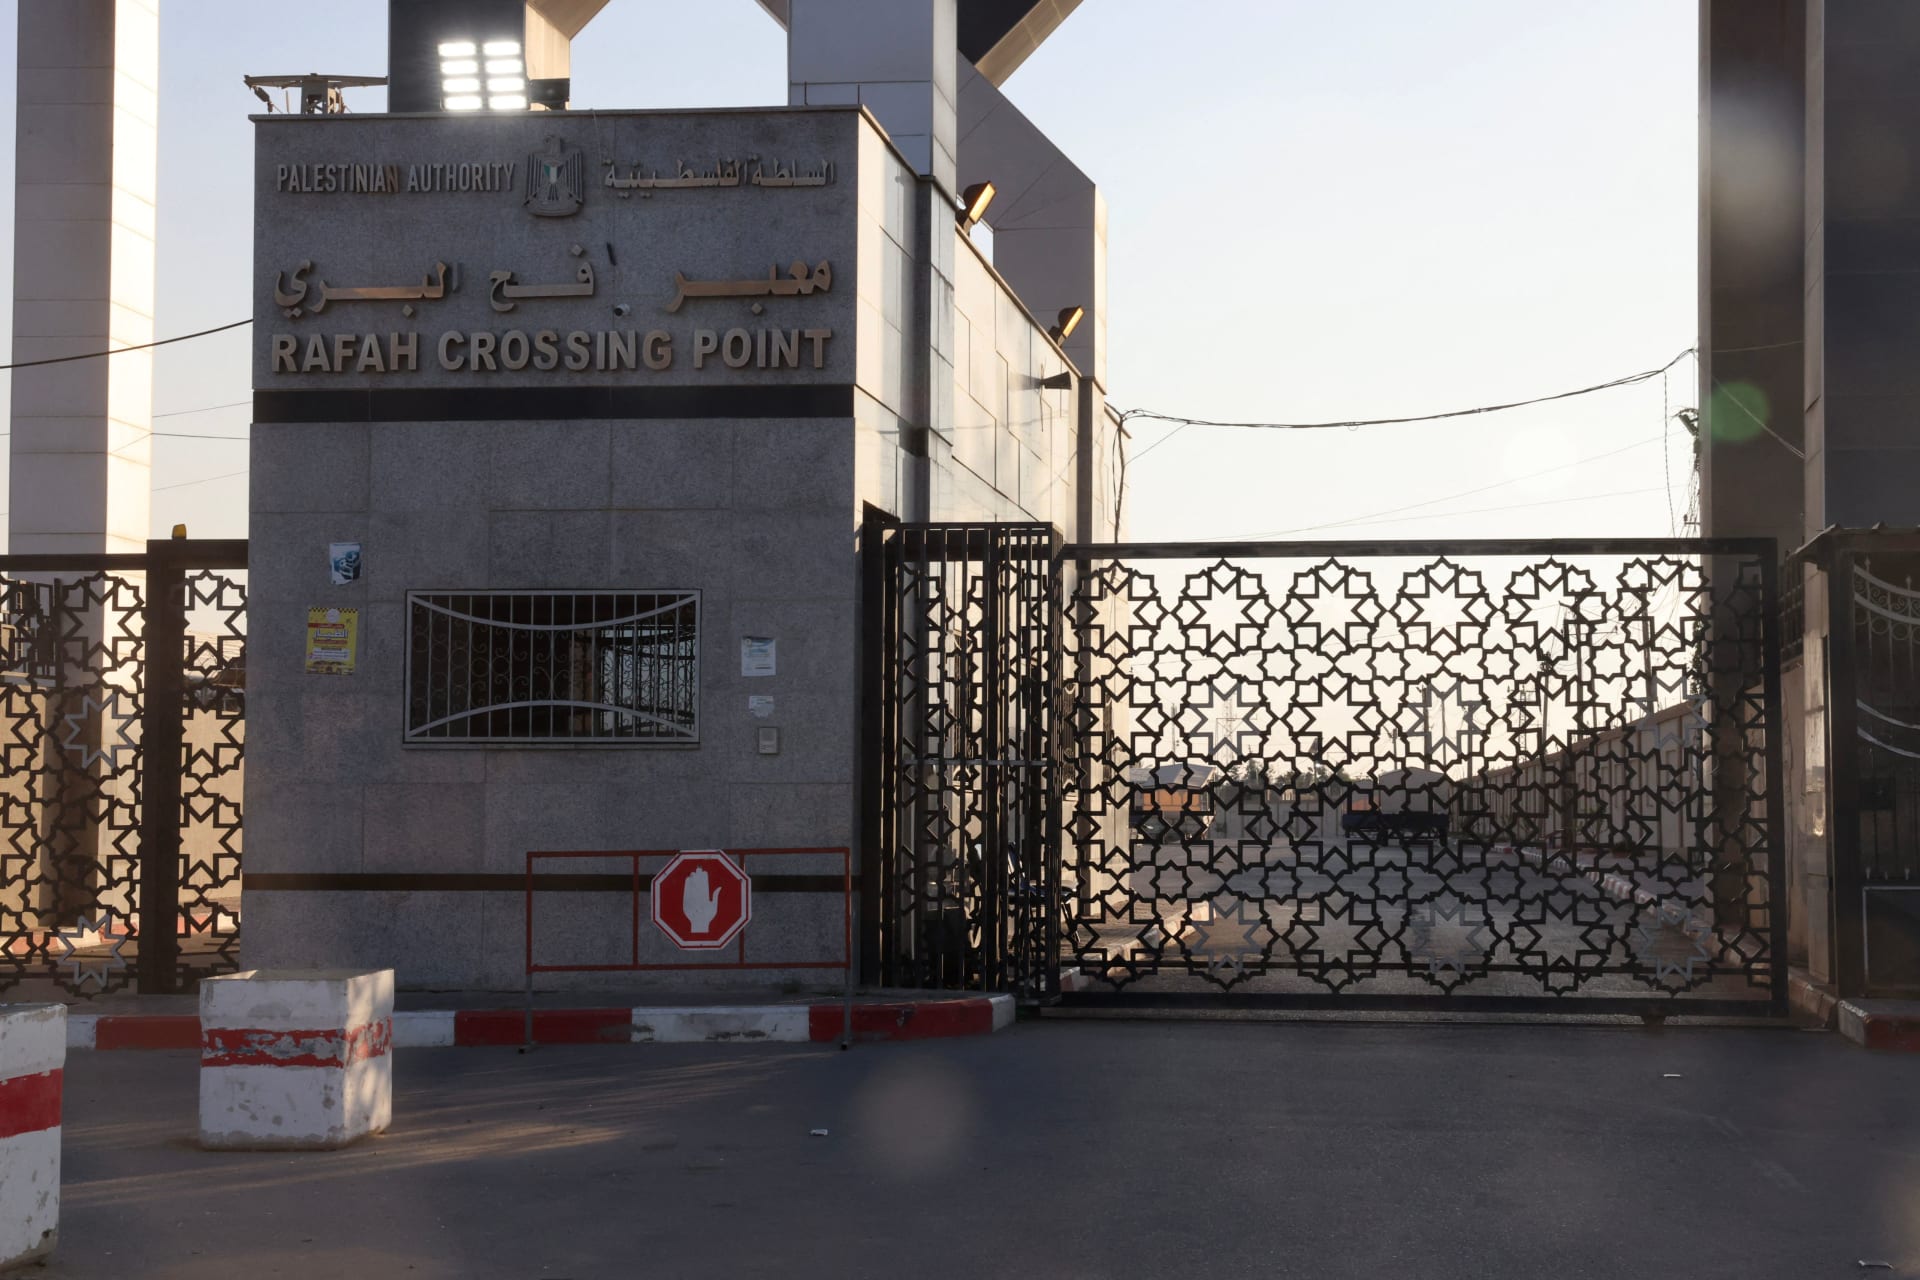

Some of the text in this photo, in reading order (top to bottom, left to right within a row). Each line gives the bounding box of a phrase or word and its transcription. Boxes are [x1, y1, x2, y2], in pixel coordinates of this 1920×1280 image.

[276, 162, 516, 193] PALESTINIAN AUTHORITY
[603, 152, 836, 199] السلطة الفلسطينية
[274, 258, 463, 319] البري
[666, 260, 832, 313] معبر
[271, 328, 832, 373] RAFAH CROSSING POINT
